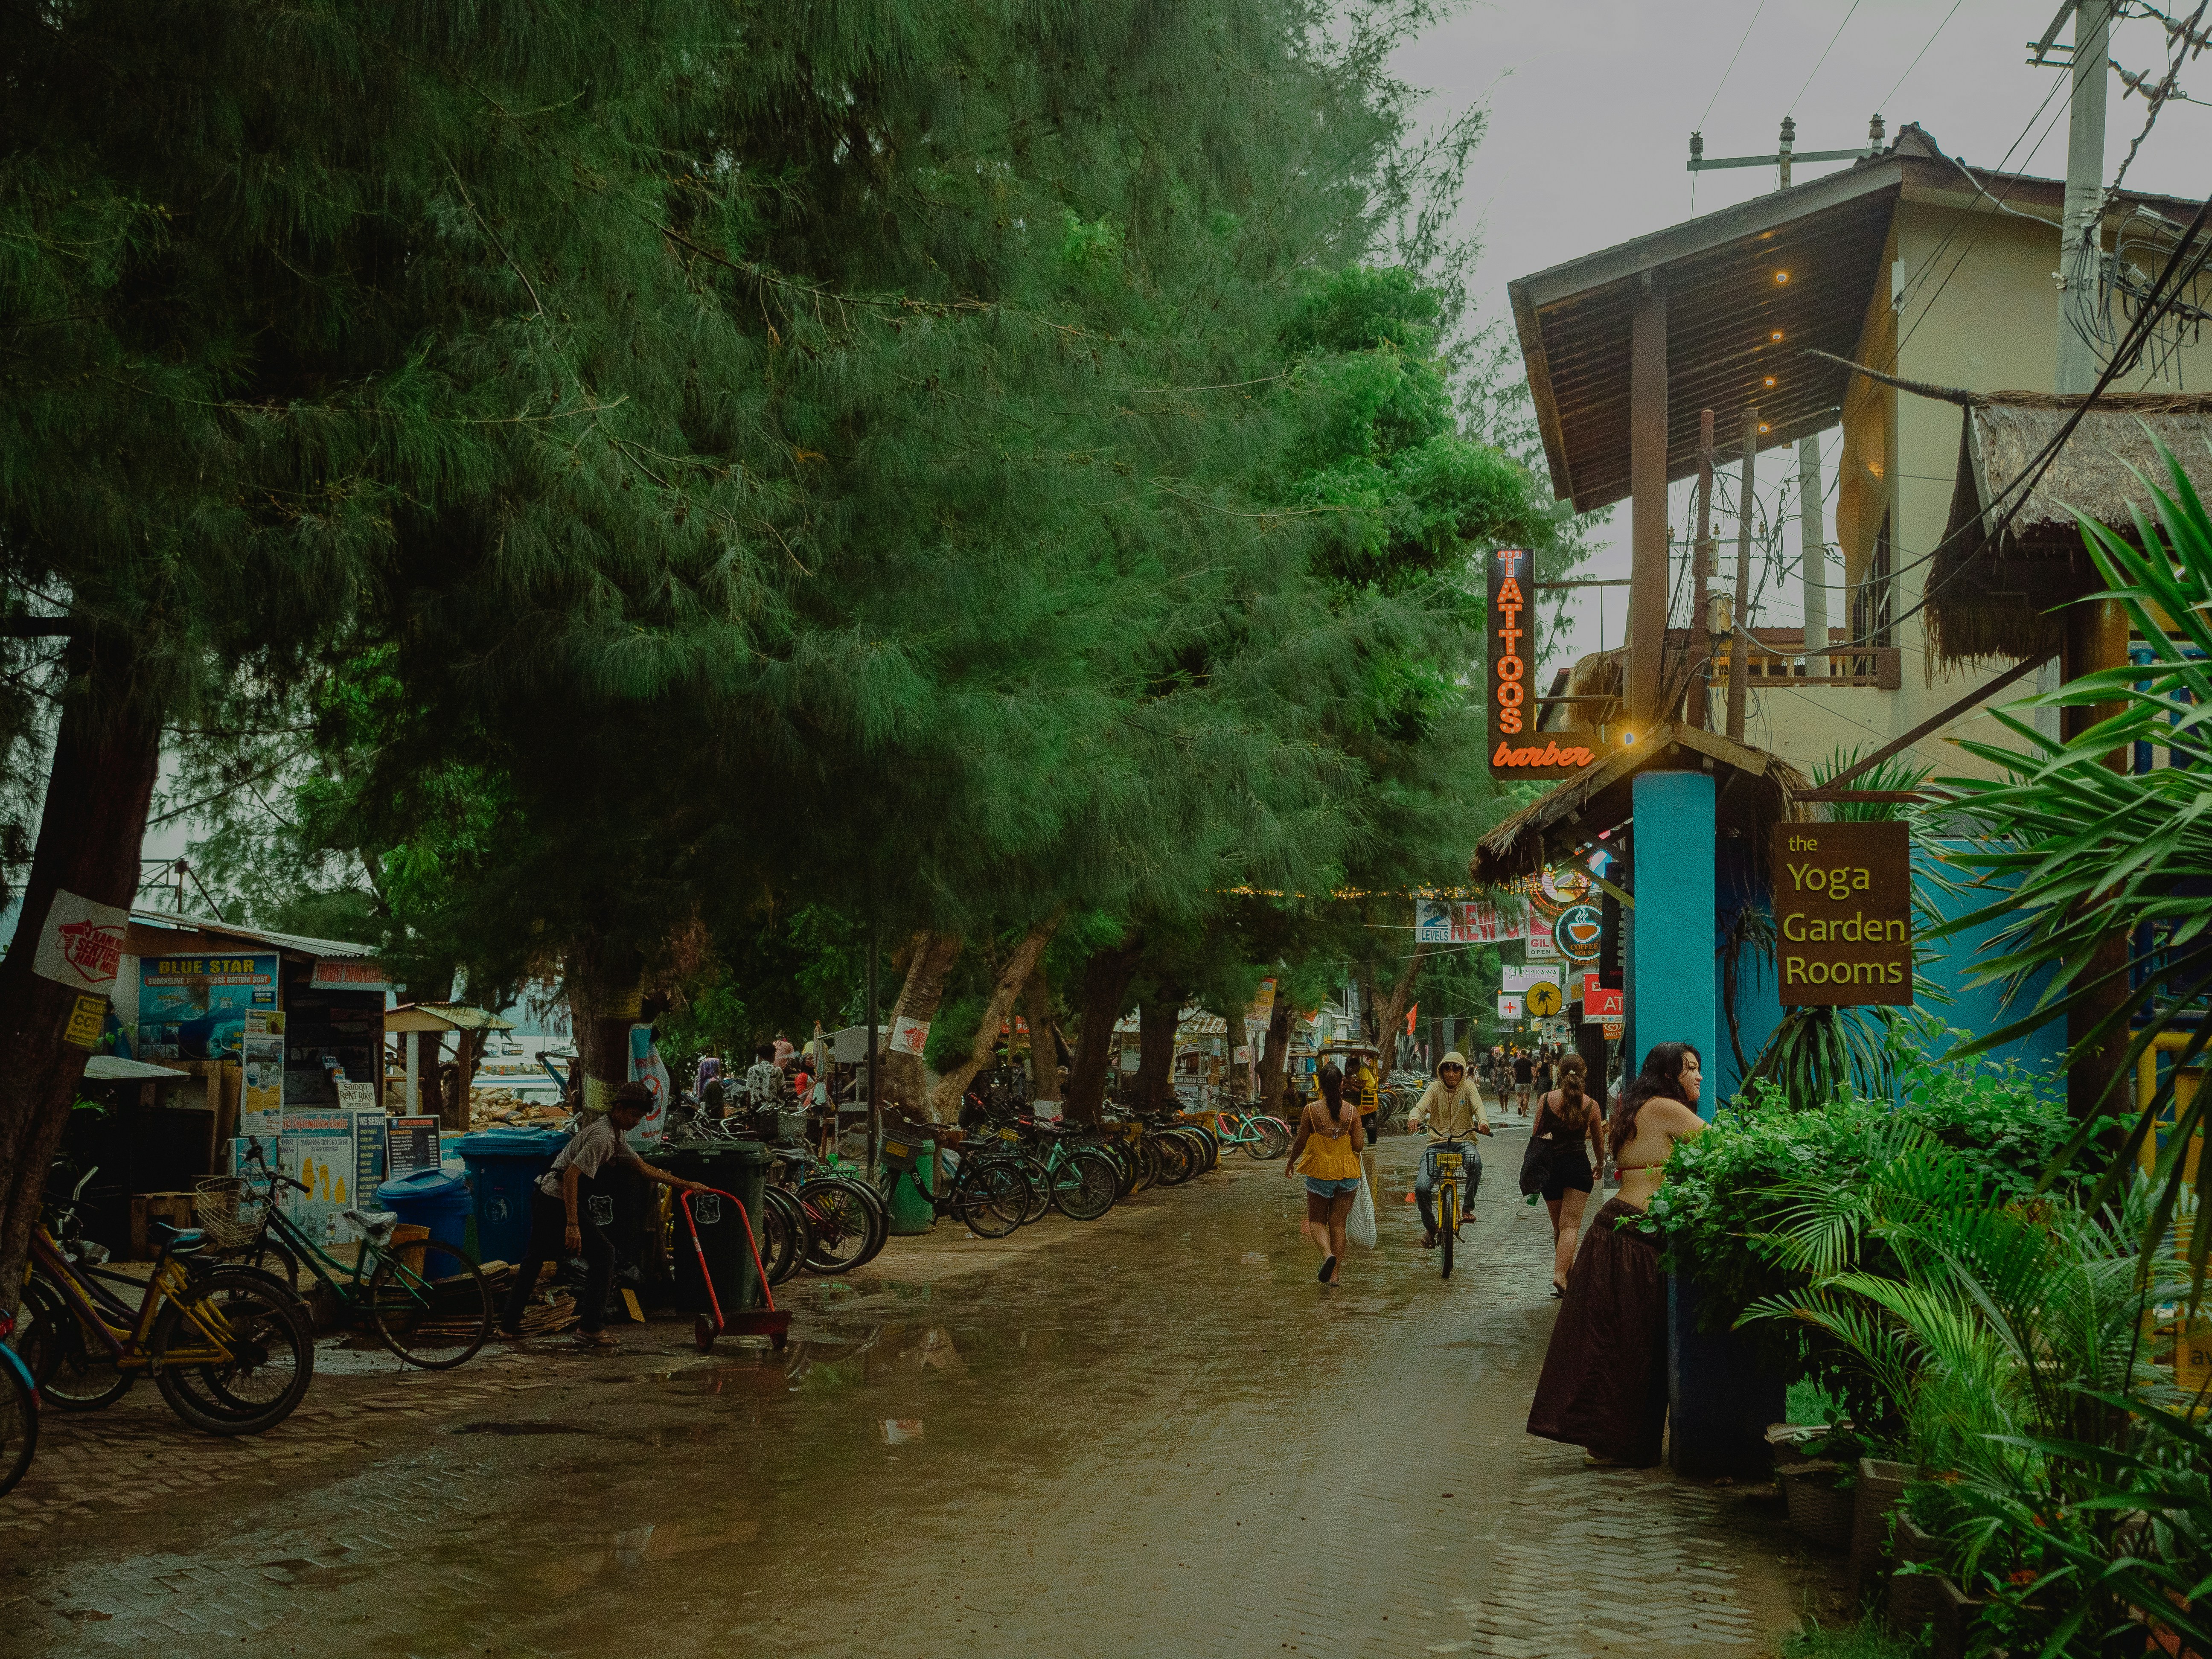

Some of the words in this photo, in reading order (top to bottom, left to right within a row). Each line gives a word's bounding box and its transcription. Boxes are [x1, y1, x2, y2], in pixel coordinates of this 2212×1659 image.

[1497, 551, 1524, 734] TATTOOS
[1493, 741, 1595, 768] barber
[1788, 835, 1818, 851] the
[1787, 863, 1870, 900] Yoga
[1451, 905, 1496, 941] NEW
[1783, 911, 1905, 942] Garden
[1422, 930, 1448, 941] LEVELS
[75, 952, 96, 969] HAK
[158, 960, 203, 974] BLUE
[209, 959, 255, 973] STAR
[1785, 957, 1903, 985] Rooms
[207, 976, 225, 984] LASS
[1604, 996, 1623, 1011] AT
[359, 1116, 367, 1126] WE
[368, 1116, 384, 1126] SERVE
